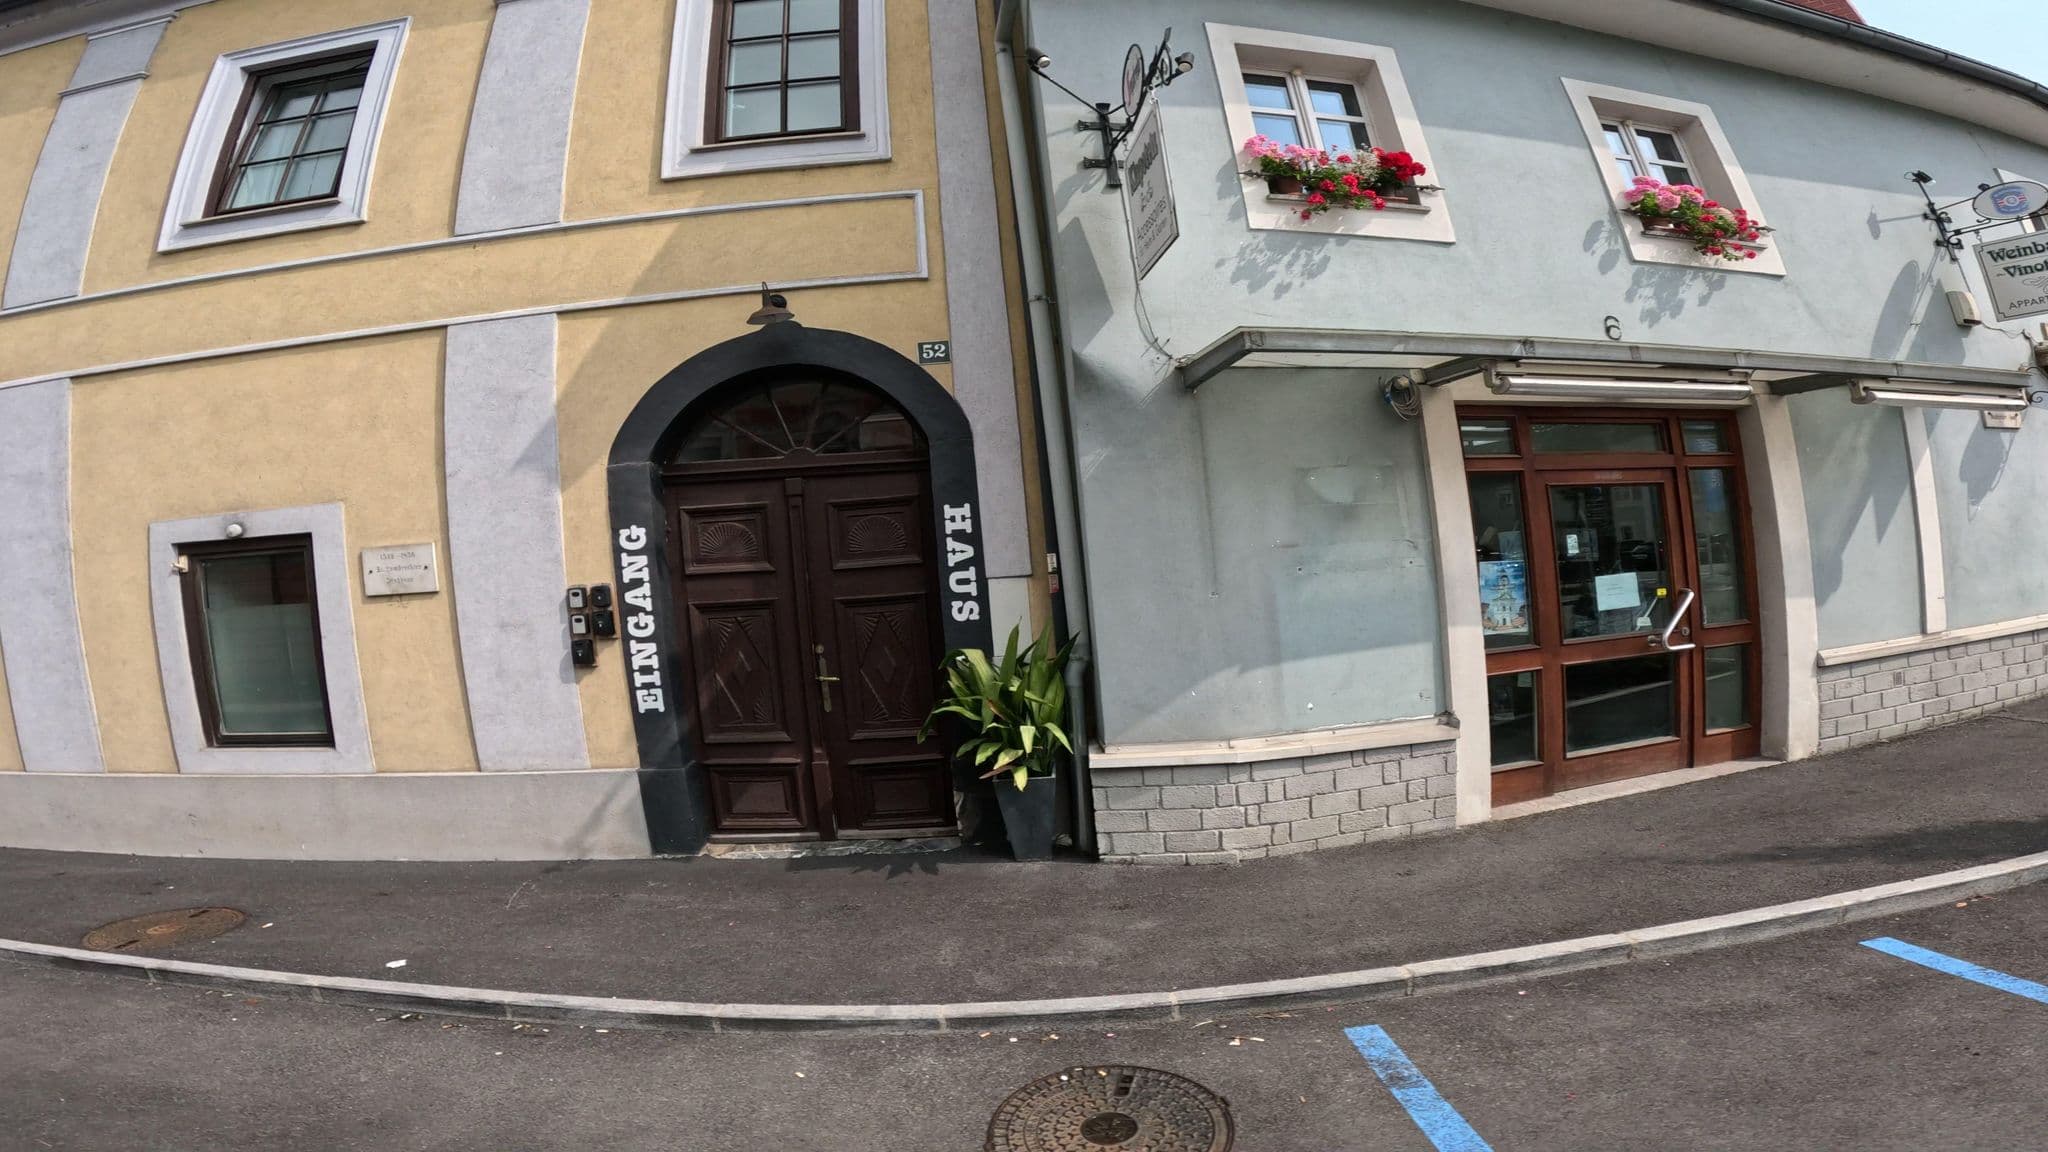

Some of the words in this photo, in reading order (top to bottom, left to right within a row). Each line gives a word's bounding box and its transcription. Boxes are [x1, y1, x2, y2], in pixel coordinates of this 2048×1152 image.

[922, 343, 946, 359] 52
[1604, 315, 1622, 341] 6
[943, 502, 980, 622] HAUS
[618, 524, 665, 714] EINGANG
